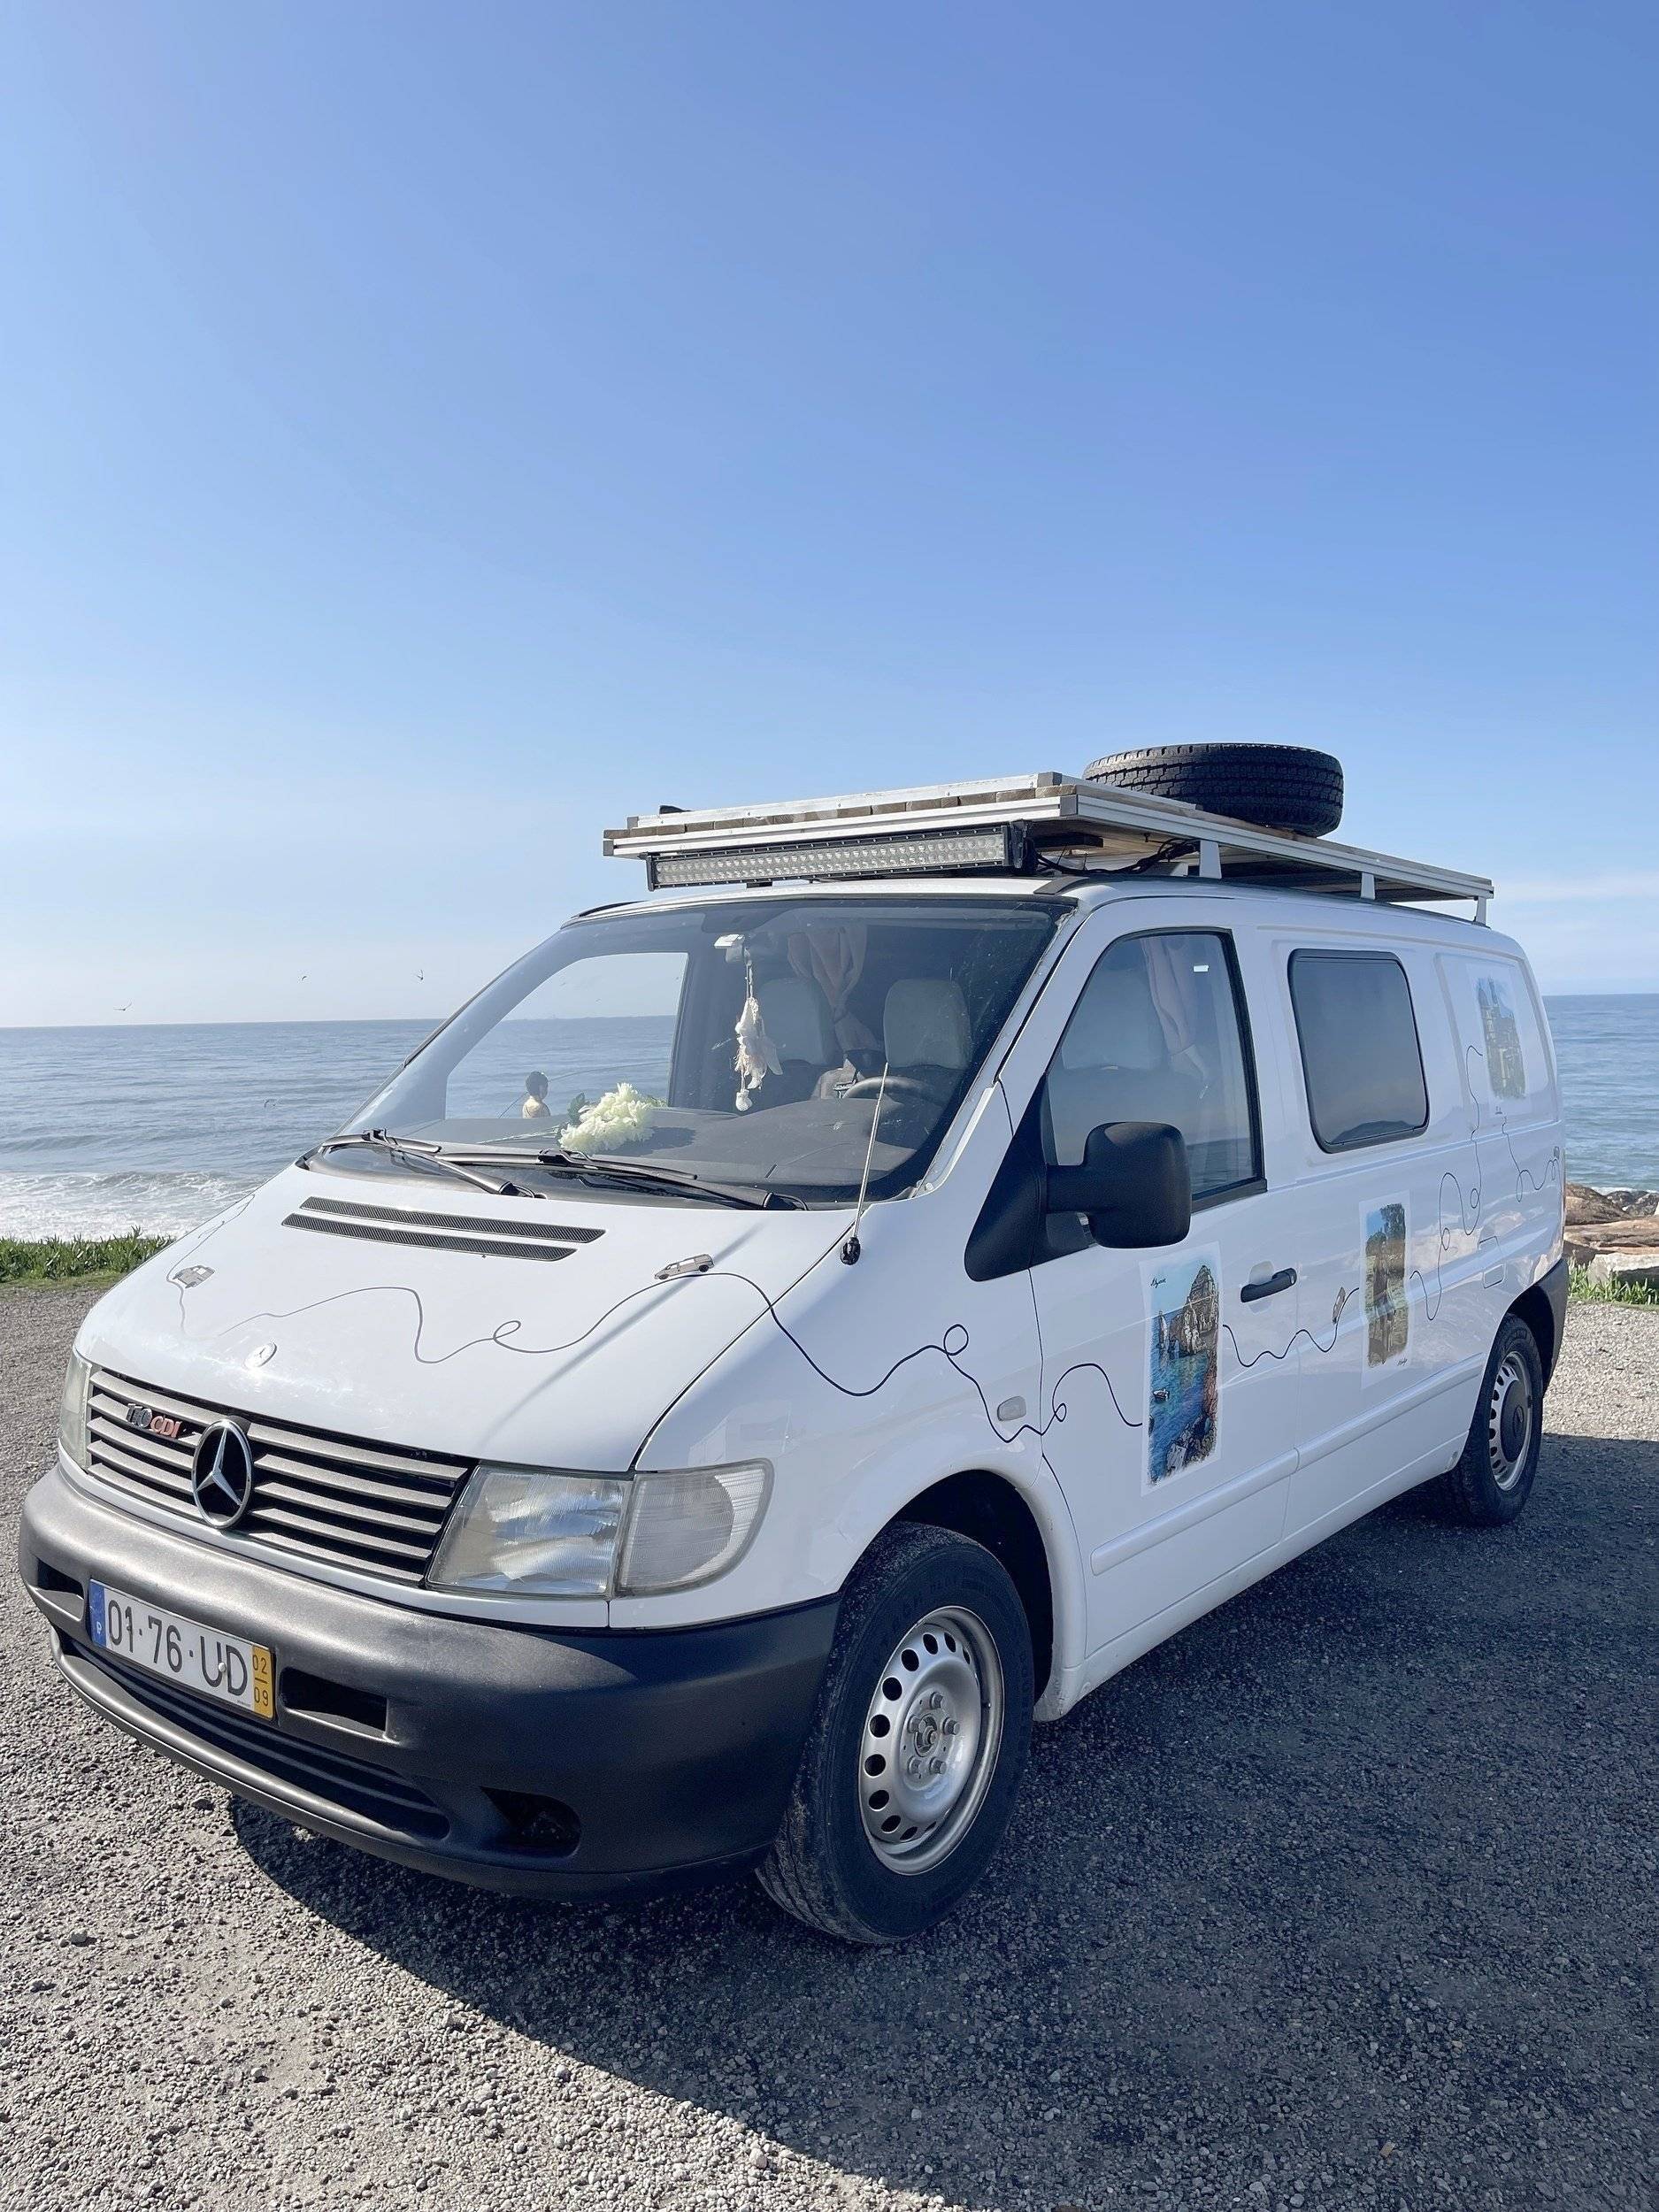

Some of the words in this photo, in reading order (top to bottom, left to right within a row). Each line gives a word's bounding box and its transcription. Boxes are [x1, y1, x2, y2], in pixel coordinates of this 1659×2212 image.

[150, 1416, 182, 1438] CDI
[252, 1655, 269, 1675] 02
[253, 1686, 269, 1707] 09
